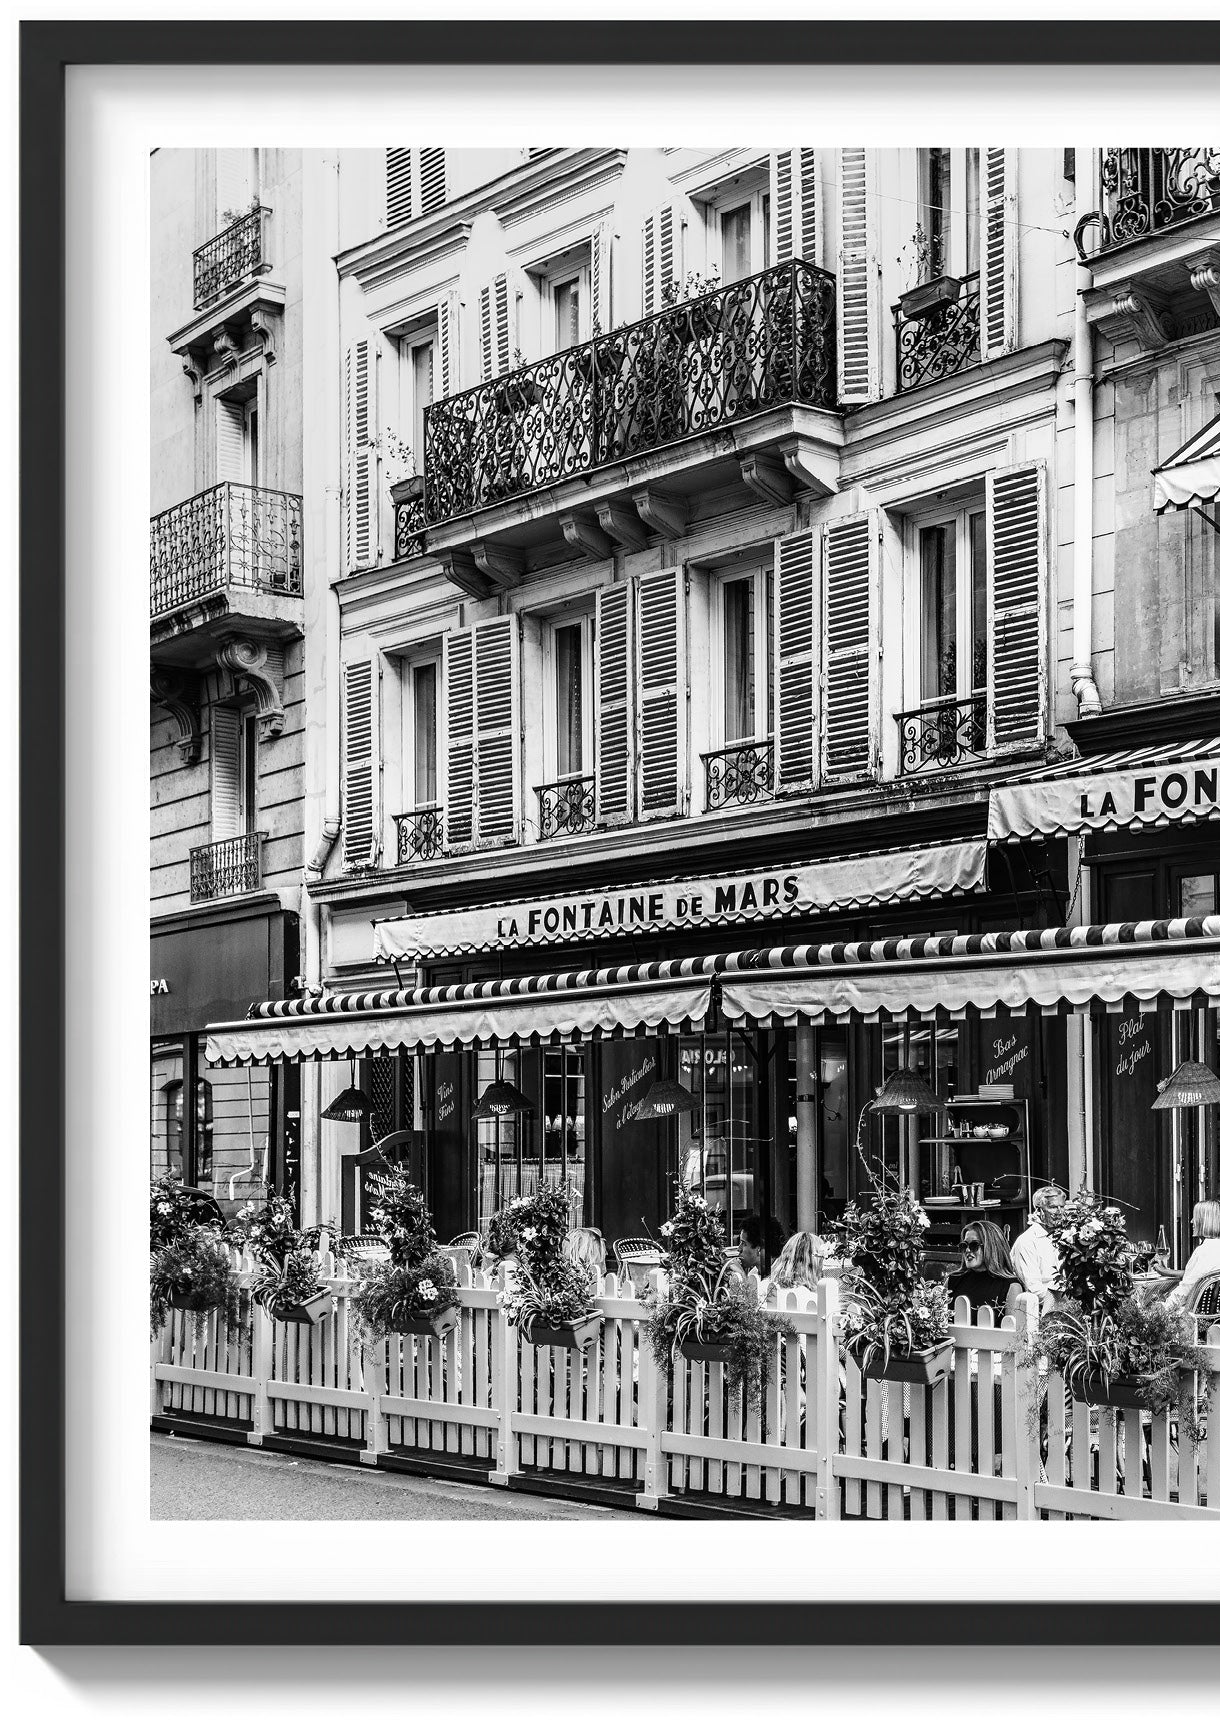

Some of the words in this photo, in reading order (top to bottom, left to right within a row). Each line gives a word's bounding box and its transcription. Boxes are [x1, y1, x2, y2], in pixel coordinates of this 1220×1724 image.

[1081, 794, 1118, 819] LA
[497, 919, 519, 938] LA
[528, 893, 664, 935] FONTAINE
[676, 896, 703, 918] DE
[714, 875, 799, 914] MARS
[1118, 1011, 1146, 1046] Plat
[992, 1033, 1018, 1059] Bas
[1116, 1053, 1129, 1076] du
[1128, 1039, 1152, 1076] jour
[437, 1082, 454, 1102] Vins
[602, 1087, 621, 1113] Salon
